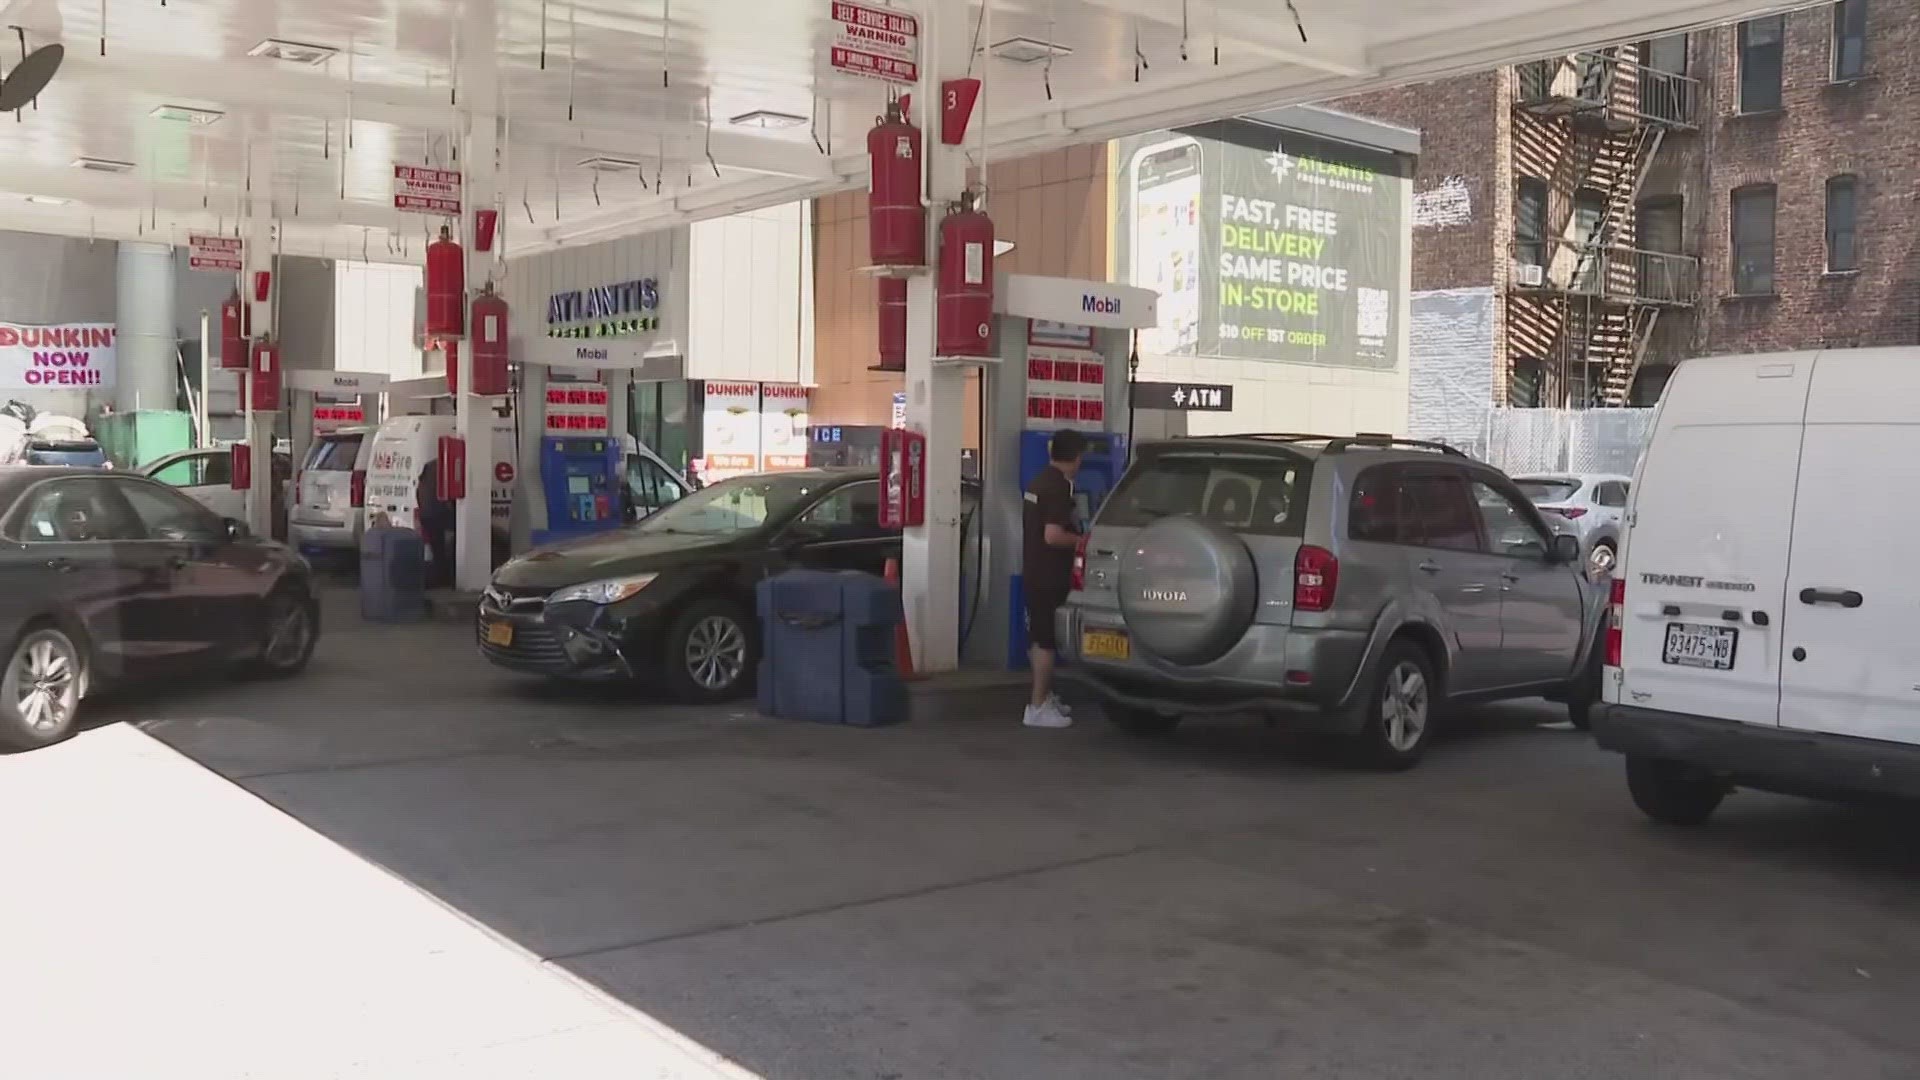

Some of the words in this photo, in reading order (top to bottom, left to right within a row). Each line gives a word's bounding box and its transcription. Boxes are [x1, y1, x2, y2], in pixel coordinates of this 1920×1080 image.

[846, 24, 906, 46] WARNING
[947, 90, 957, 110] 3
[1297, 155, 1374, 183] ATLANTIS
[406, 181, 452, 192] WARNING
[1329, 179, 1373, 193] DELIVERY
[1221, 193, 1281, 230] FAST,
[1285, 204, 1337, 235] FREE
[1221, 222, 1325, 261] DELIVERY
[1220, 252, 1282, 283] SAME
[1288, 260, 1349, 291] PRICE
[547, 277, 659, 324] ATLANTIS
[1082, 294, 1121, 315] Mobil
[1220, 281, 1320, 316] IN-STORE
[0, 327, 116, 348] DUNKIN'
[1219, 322, 1239, 340] $10
[1240, 326, 1266, 342] OFF
[1287, 330, 1326, 346] ORDER
[33, 351, 89, 367] NOW
[576, 347, 608, 360] Mobil
[25, 369, 101, 385] OPEN!!
[334, 377, 359, 387] Mobil
[706, 384, 758, 397] DUNKIN'
[1188, 389, 1223, 407] ATM
[814, 427, 841, 442] ICE
[1639, 571, 1704, 588] TRANSIT
[1142, 590, 1187, 601] TOYOTA
